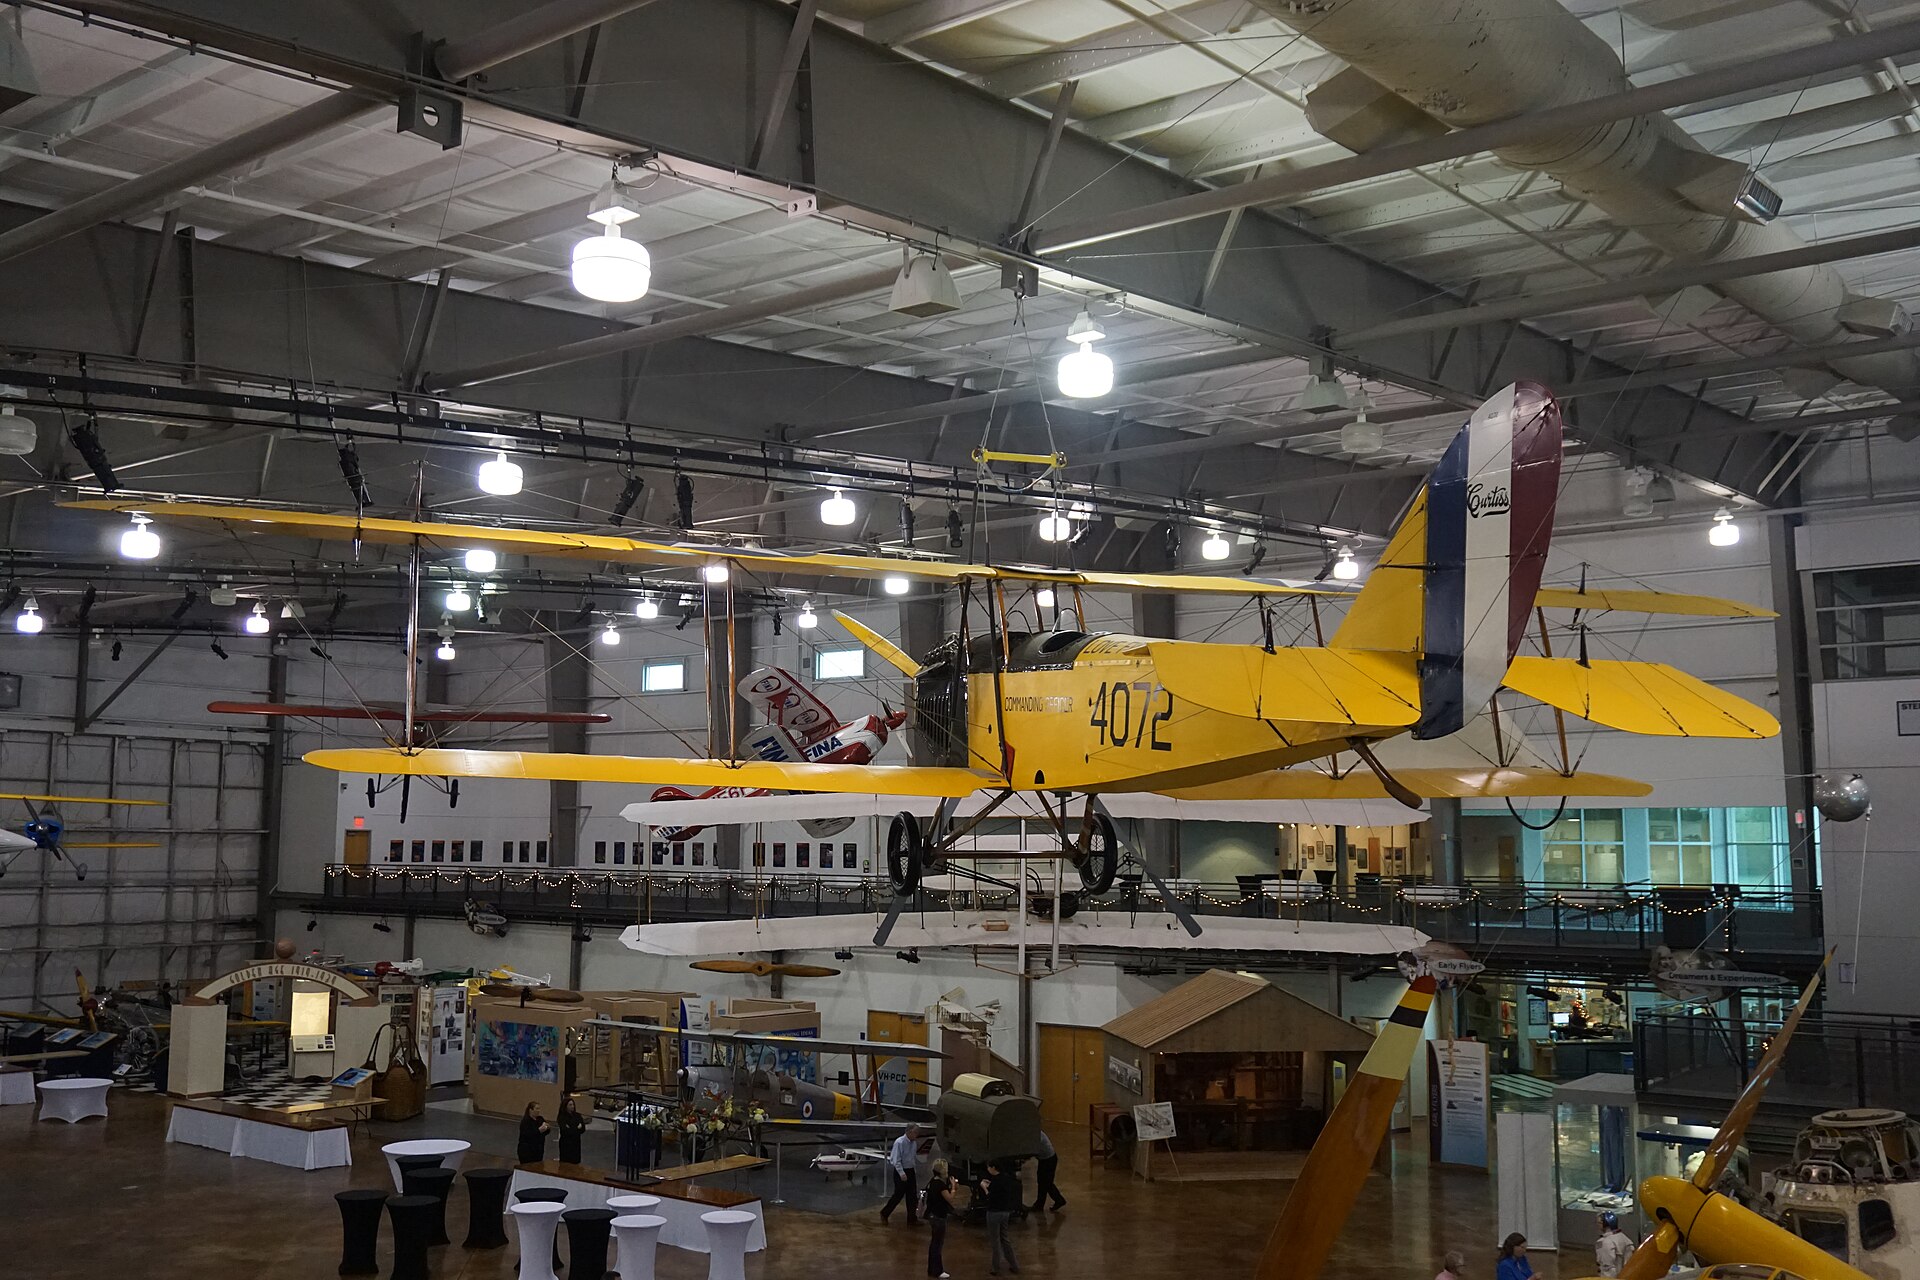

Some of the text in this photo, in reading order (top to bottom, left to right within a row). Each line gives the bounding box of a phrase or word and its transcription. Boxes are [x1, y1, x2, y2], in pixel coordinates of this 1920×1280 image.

[1467, 483, 1512, 518] Curtiss
[1004, 697, 1043, 712] COMMANDING
[1090, 682, 1174, 752] 4072
[751, 736, 789, 762] FIN
[805, 736, 843, 758] FINA
[229, 967, 262, 984] GOLDEN
[268, 963, 285, 976] AGE
[1438, 961, 1483, 971] Early Flyers
[1668, 971, 1708, 980] Dreamers
[1717, 973, 1781, 984] Experimenters
